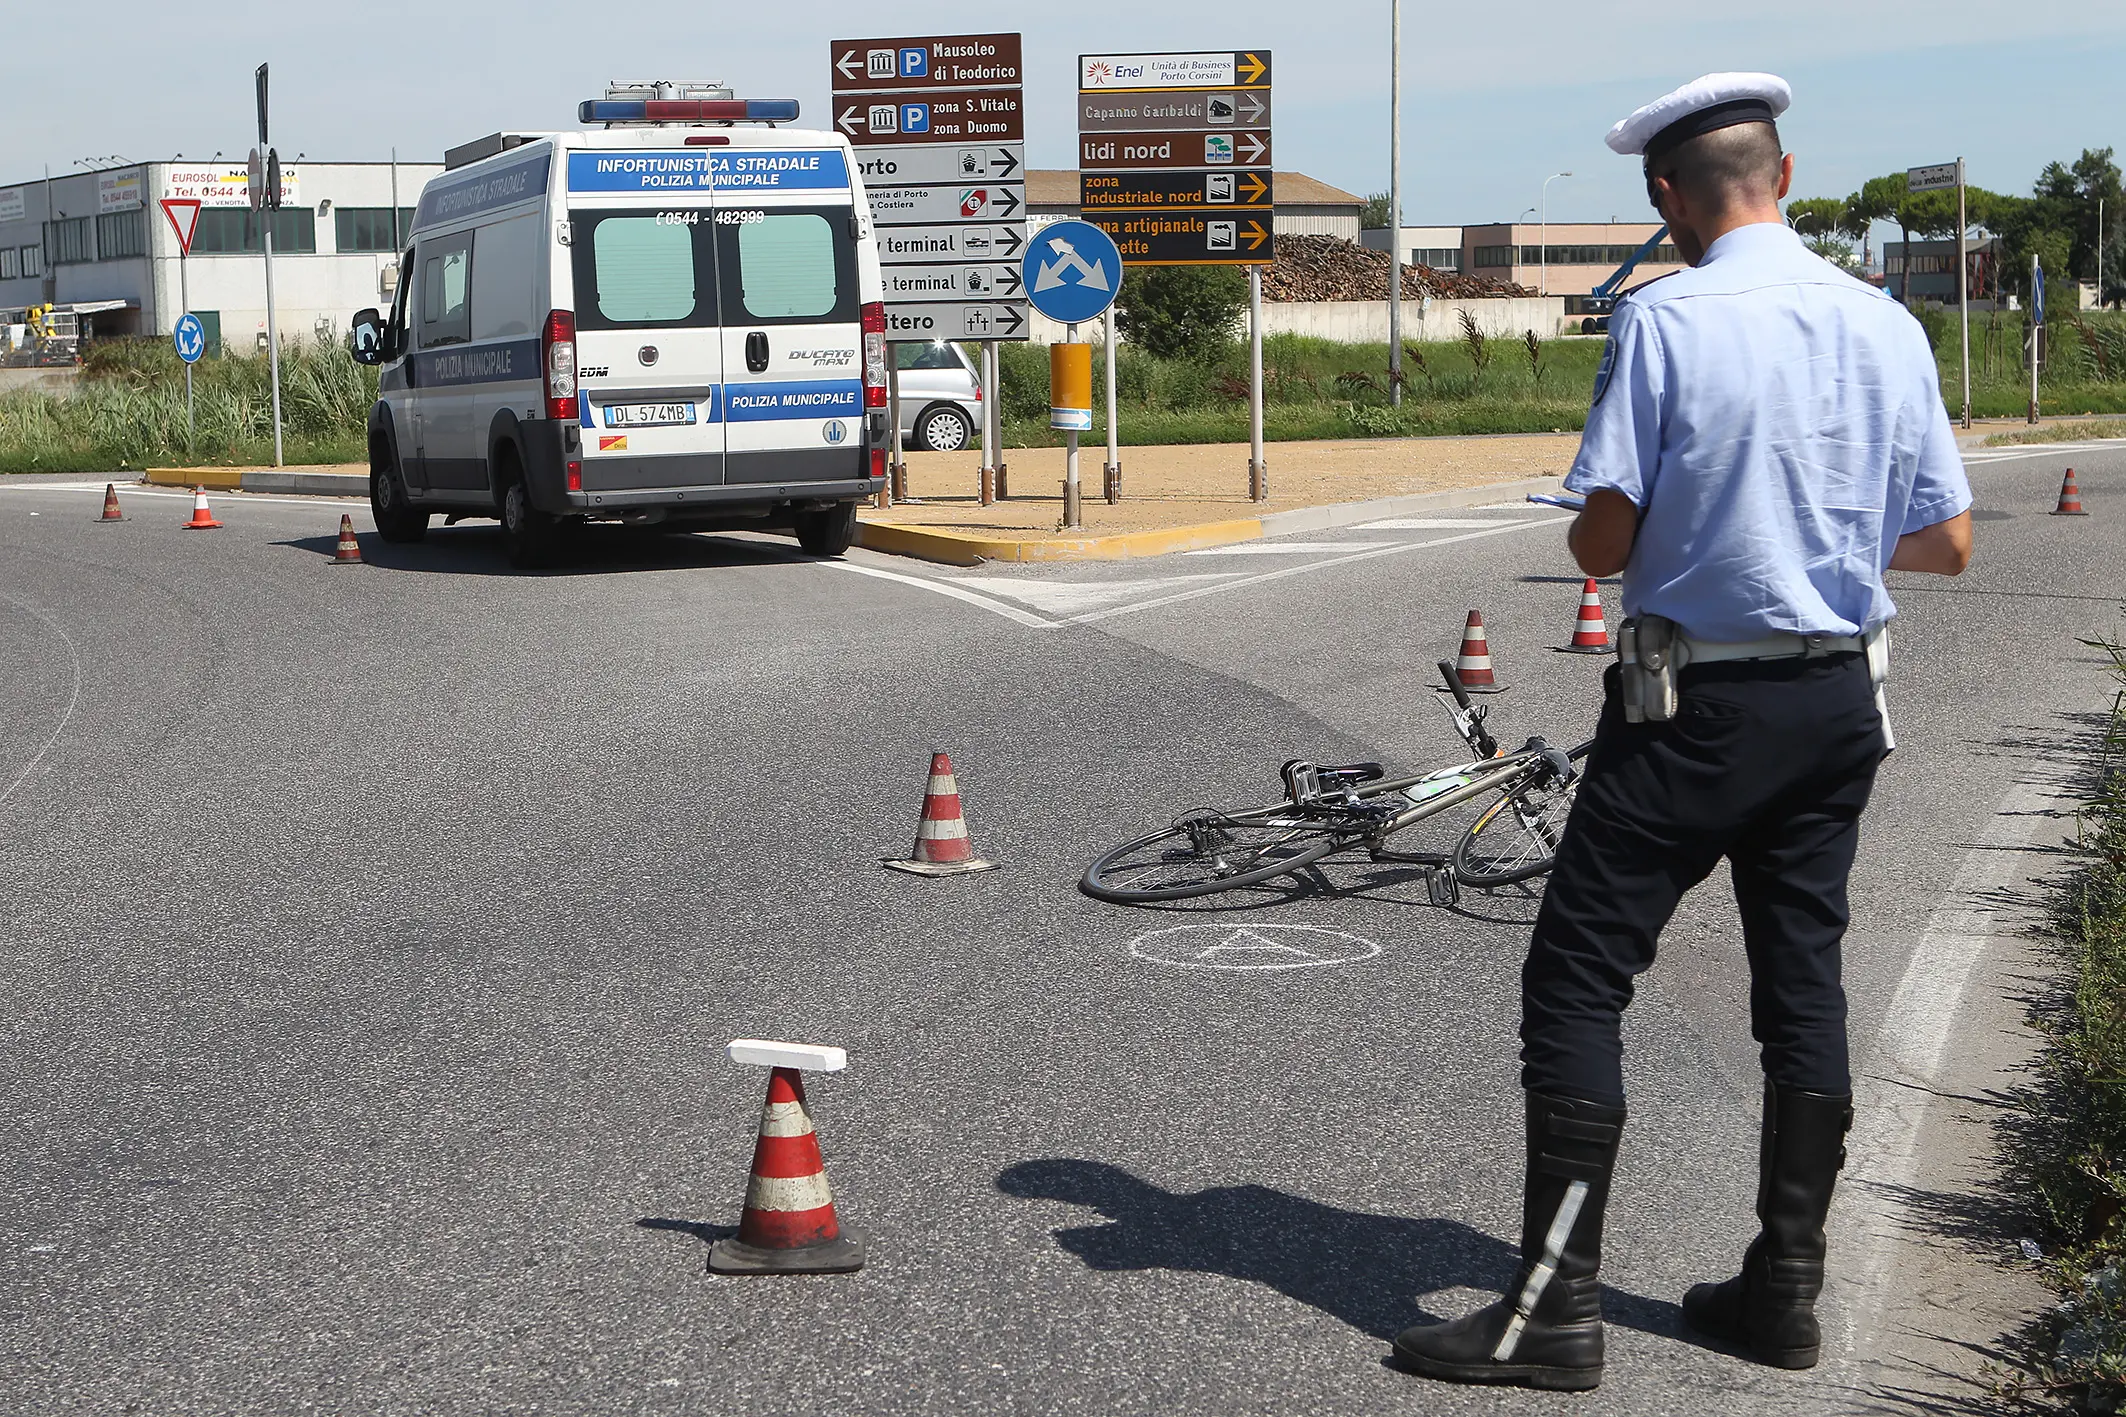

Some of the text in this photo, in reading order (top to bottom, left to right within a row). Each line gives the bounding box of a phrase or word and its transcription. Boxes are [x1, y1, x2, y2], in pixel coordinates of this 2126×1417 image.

[933, 42, 996, 58] Mausoleo
[934, 64, 1016, 80] di Teodorico
[1114, 60, 1232, 78] Enel Unità di Business
[1160, 70, 1222, 80] Porto Corsini
[934, 102, 959, 114] zona
[1085, 104, 1202, 121] Capanno Garibaldi
[934, 120, 1007, 134] zona Duomo
[1084, 142, 1171, 160] lidi nord
[597, 157, 820, 173] INFORTUNISTICA STRADALE
[858, 158, 898, 174] orto
[172, 173, 219, 182] EUROSOL
[641, 174, 780, 187] POLIZIA MUNICIPALE
[1086, 177, 1120, 188] zona
[174, 187, 197, 196] Tel.
[202, 187, 233, 196] 0544
[435, 171, 528, 215] INFORTUNISTICA STRADALE
[904, 190, 929, 198] Porto
[1086, 190, 1202, 204] industriale nord
[665, 211, 698, 225] 0544
[715, 210, 764, 224] 482999
[1124, 218, 1205, 236] artigianale
[888, 234, 956, 253] terminal
[1117, 239, 1149, 254] ette
[894, 274, 956, 290] terminal
[884, 313, 934, 330] itero
[788, 350, 855, 360] DUCATO
[436, 350, 512, 379] POLIZIA MUNICIPALE
[732, 392, 855, 408] POLIZIA MUNICIPALE
[615, 407, 634, 422] DL
[640, 406, 685, 422] 574MB
